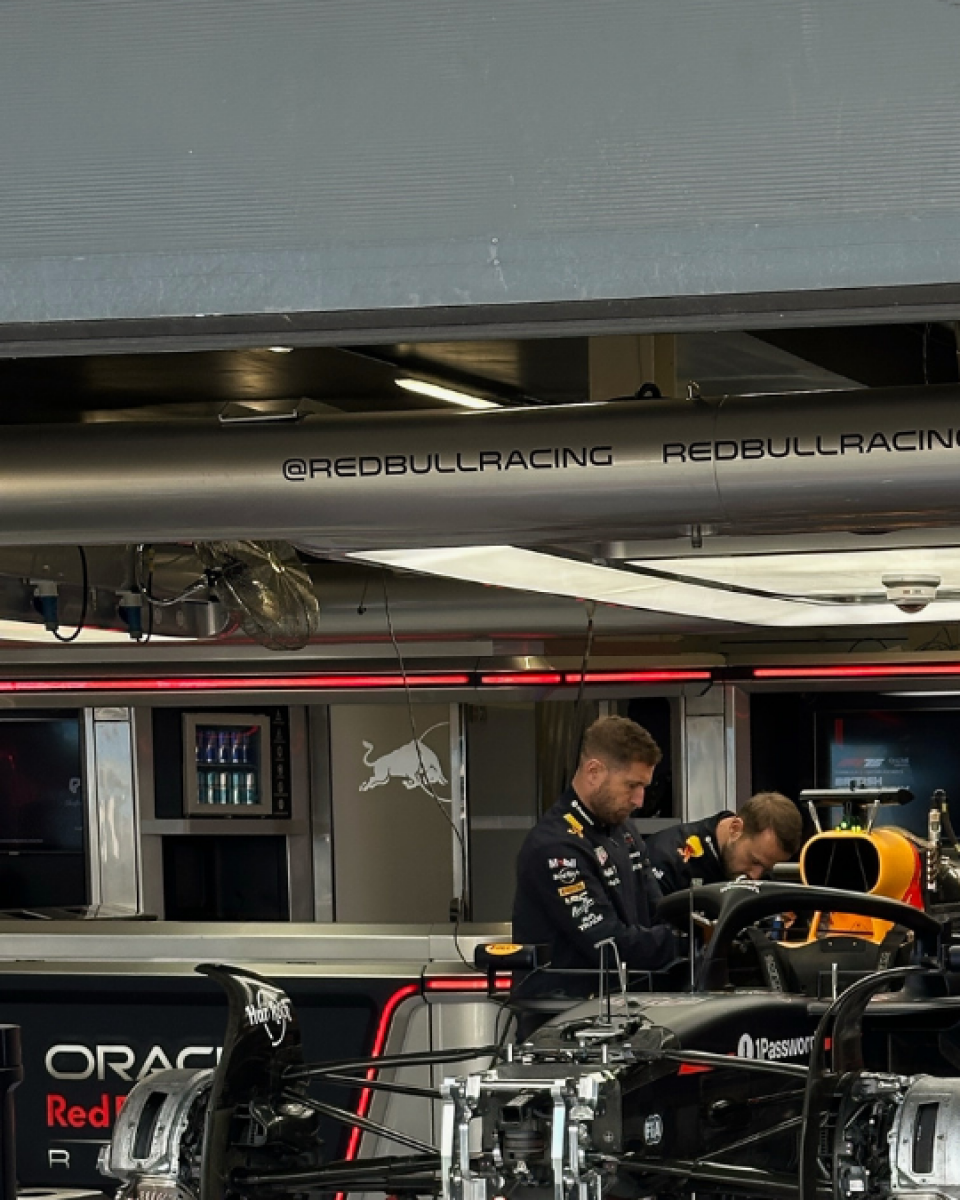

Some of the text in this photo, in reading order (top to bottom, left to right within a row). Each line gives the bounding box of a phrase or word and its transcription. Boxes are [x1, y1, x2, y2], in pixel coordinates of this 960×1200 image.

[282, 446, 613, 482] @REDBULLRACING
[754, 1036, 816, 1061] 1Passwor
[47, 1093, 110, 1129] Red
